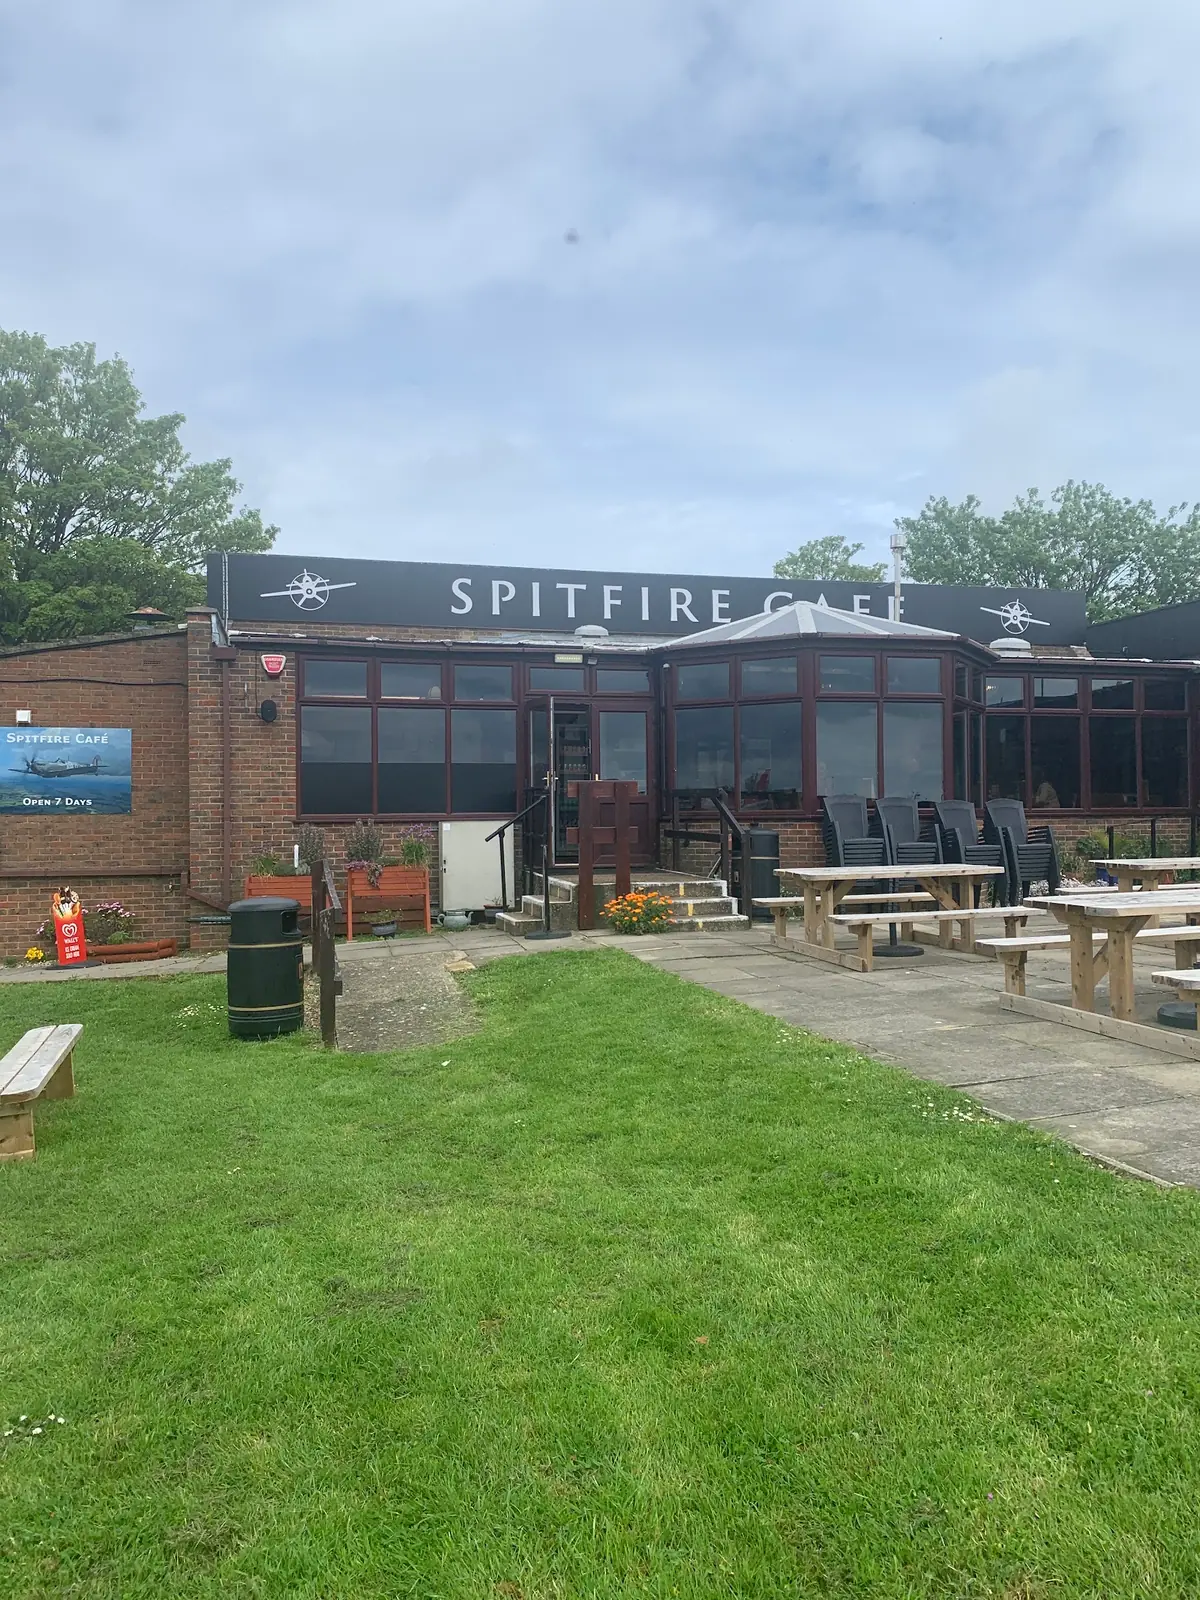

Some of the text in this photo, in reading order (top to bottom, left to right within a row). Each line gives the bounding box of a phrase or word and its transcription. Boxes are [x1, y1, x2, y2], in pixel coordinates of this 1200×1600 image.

[450, 577, 732, 624] SPITFIRE
[6, 732, 109, 744] SPITFIRE CAFÉ
[22, 797, 93, 806] OPEN 7 DAYS
